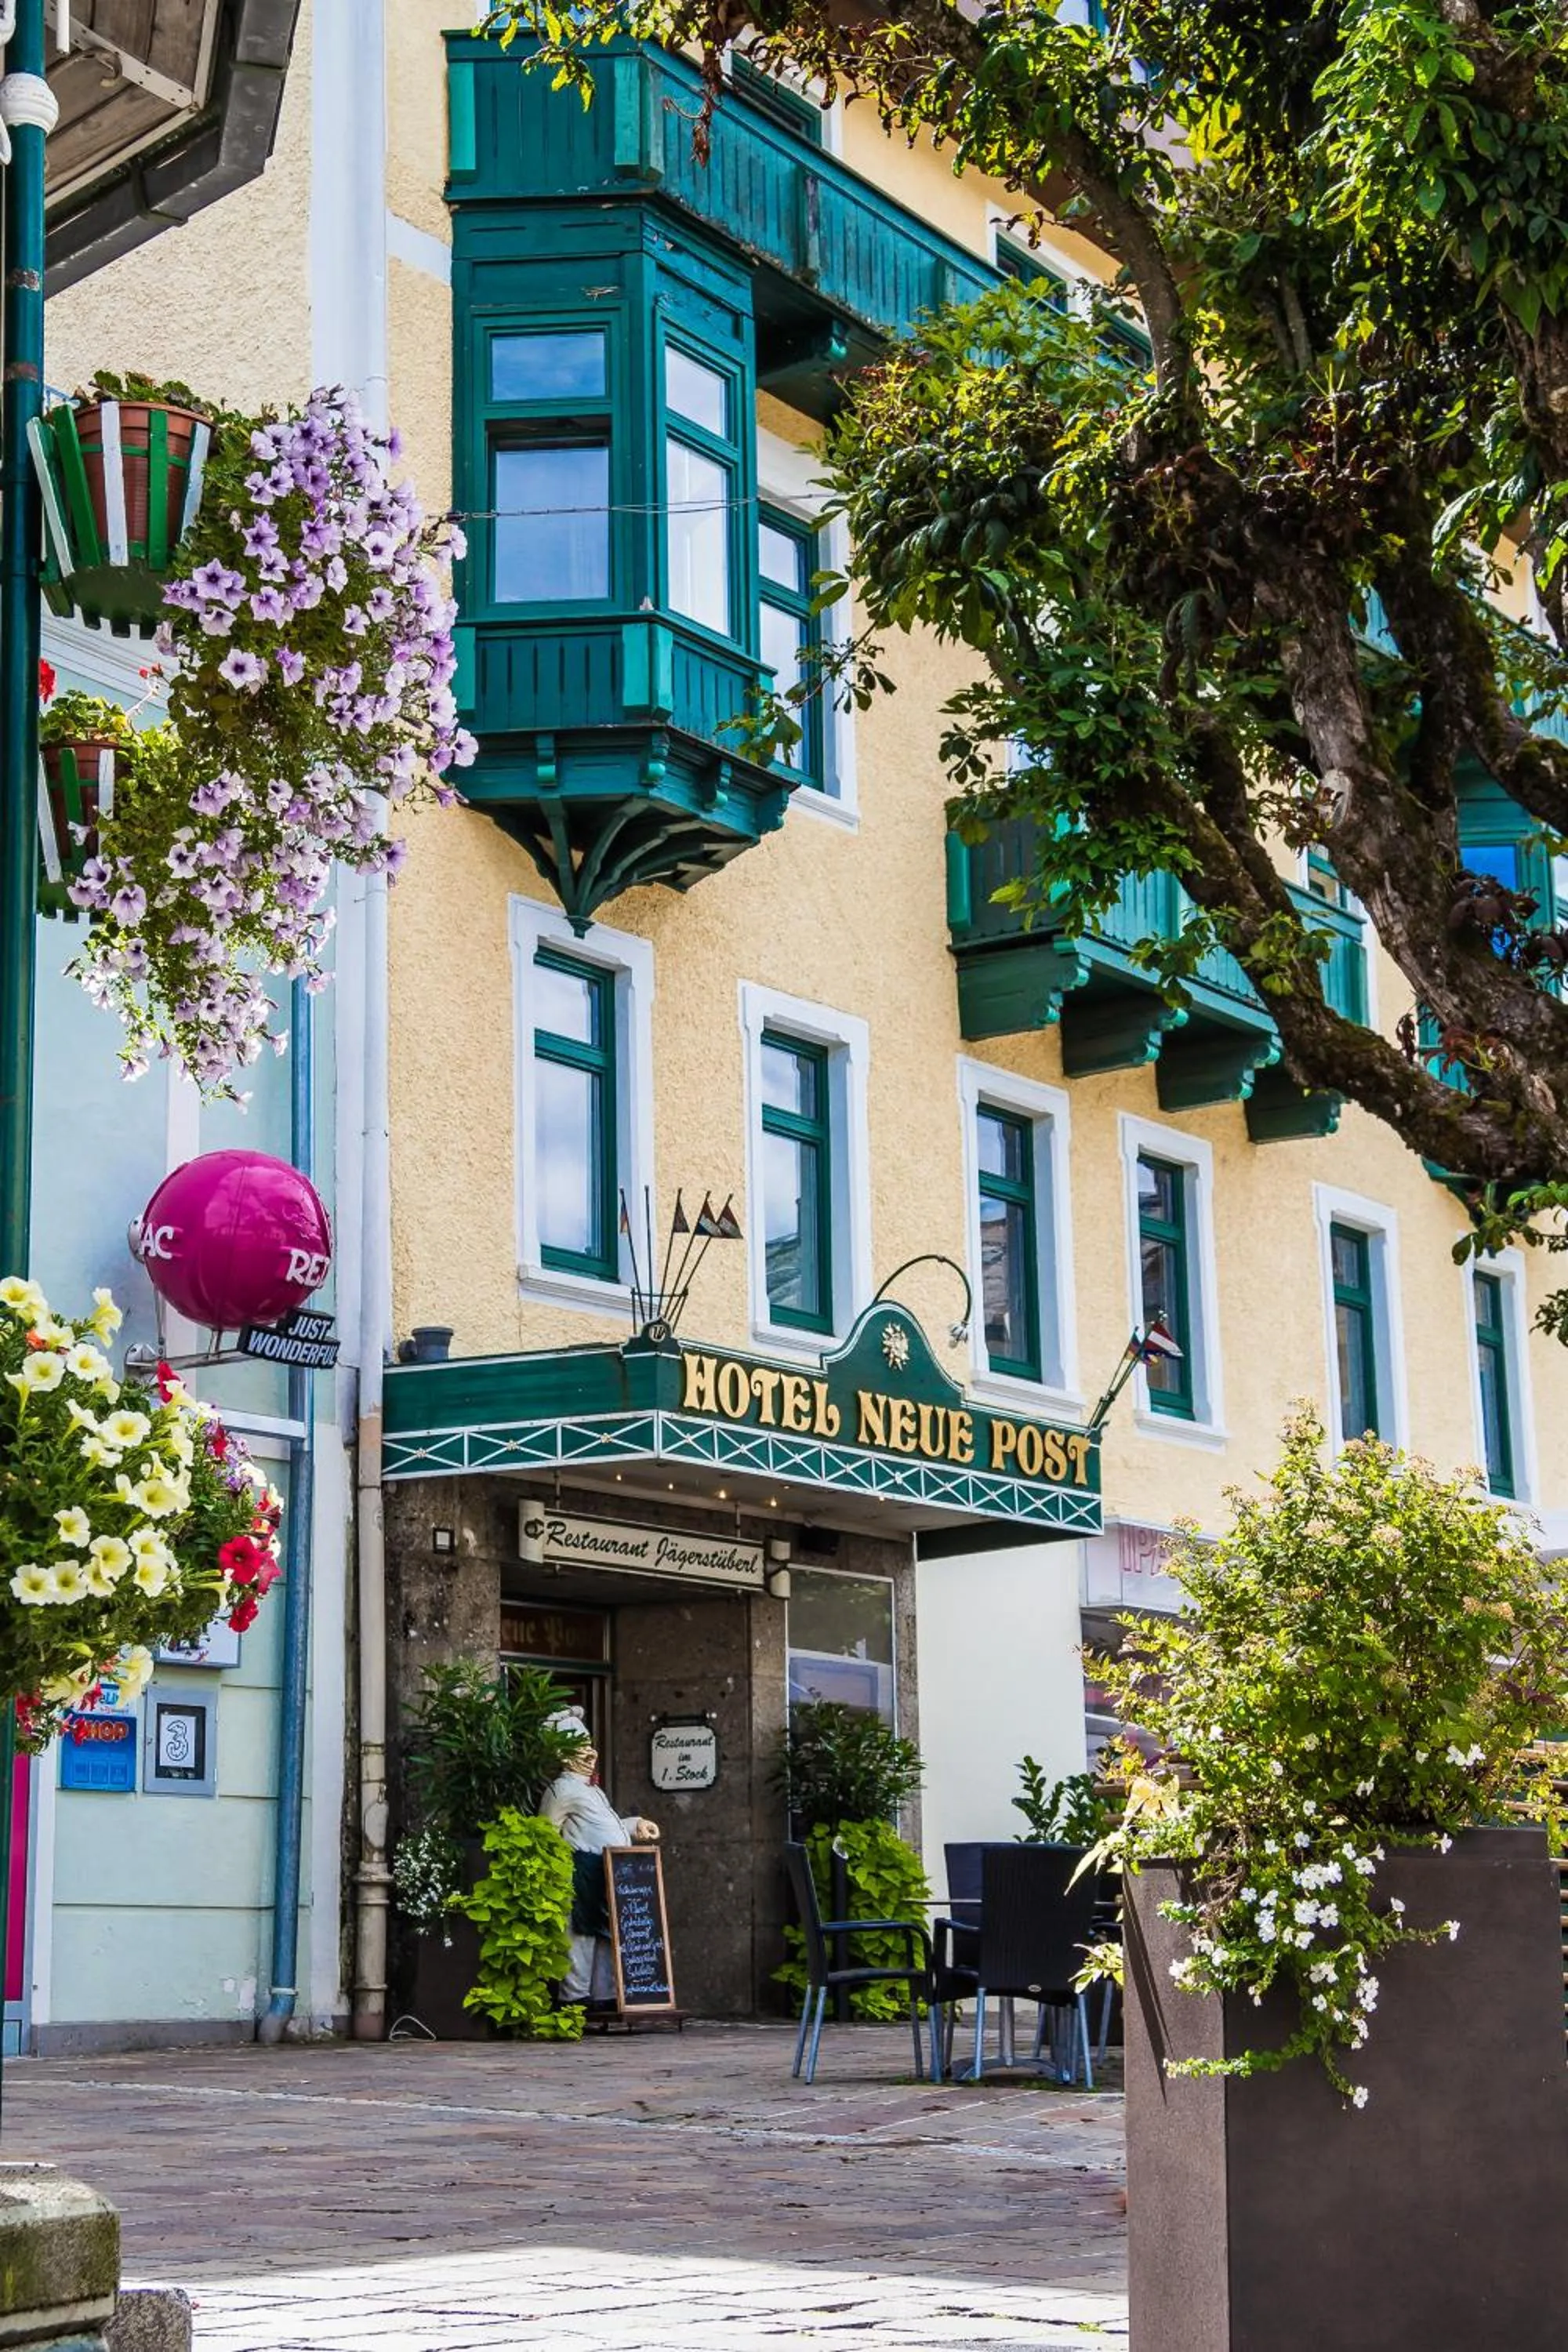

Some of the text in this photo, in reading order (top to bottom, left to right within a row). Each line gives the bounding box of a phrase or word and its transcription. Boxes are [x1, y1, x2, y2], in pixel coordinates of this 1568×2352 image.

[288, 1315, 331, 1341] JUST
[247, 1330, 338, 1366] WONDERFUL
[682, 1353, 1091, 1486] HOTEL NEUE POST
[545, 1520, 758, 1574] Restaurant Jägerstüberl
[73, 1717, 130, 1742] HOP
